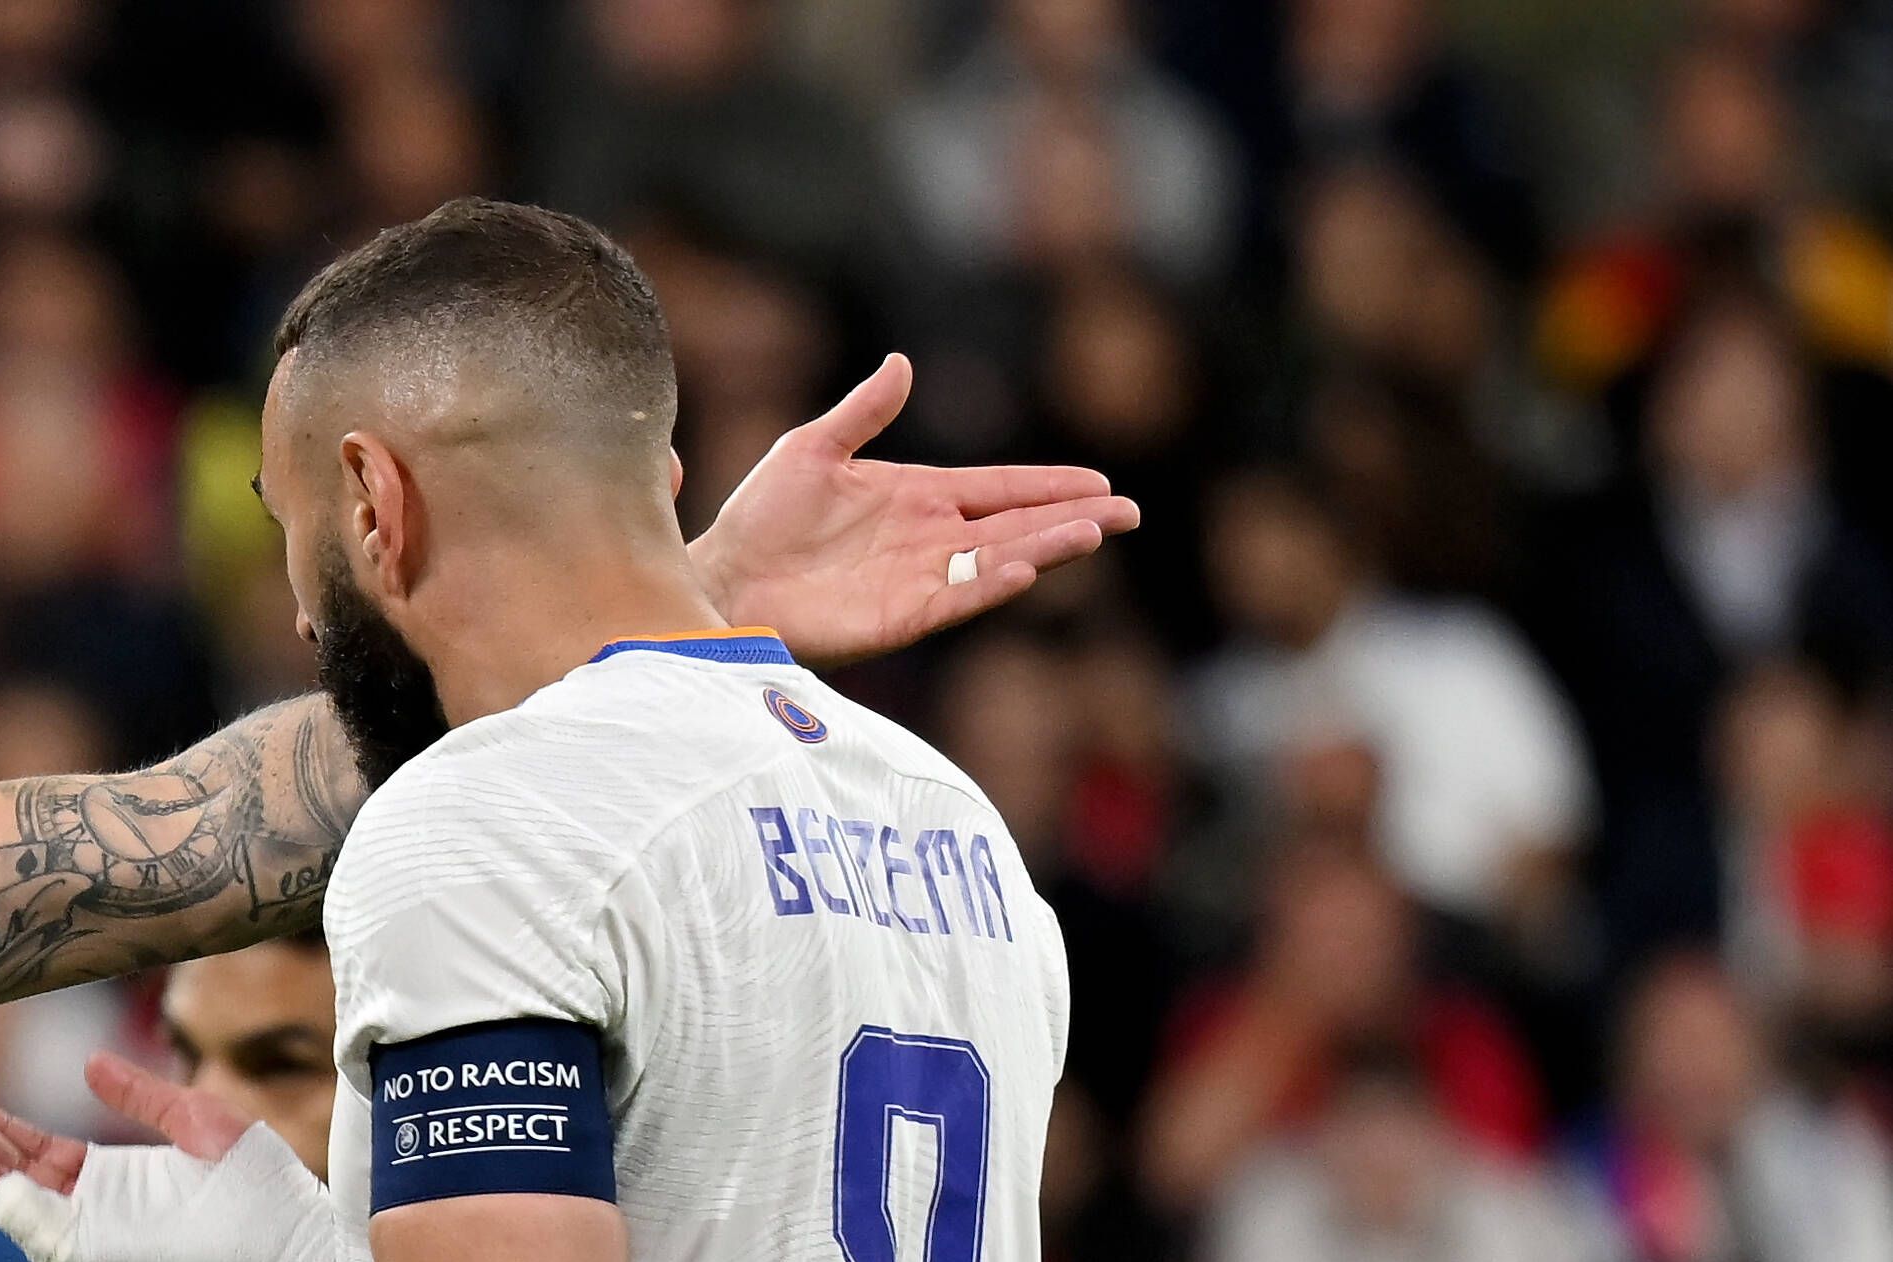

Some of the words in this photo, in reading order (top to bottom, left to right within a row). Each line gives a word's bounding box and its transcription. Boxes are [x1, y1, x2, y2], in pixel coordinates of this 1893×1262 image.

[384, 1073, 414, 1103] NO
[417, 1065, 455, 1094] TO
[461, 1060, 581, 1090] RACISM
[428, 1113, 569, 1148] RESPECT
